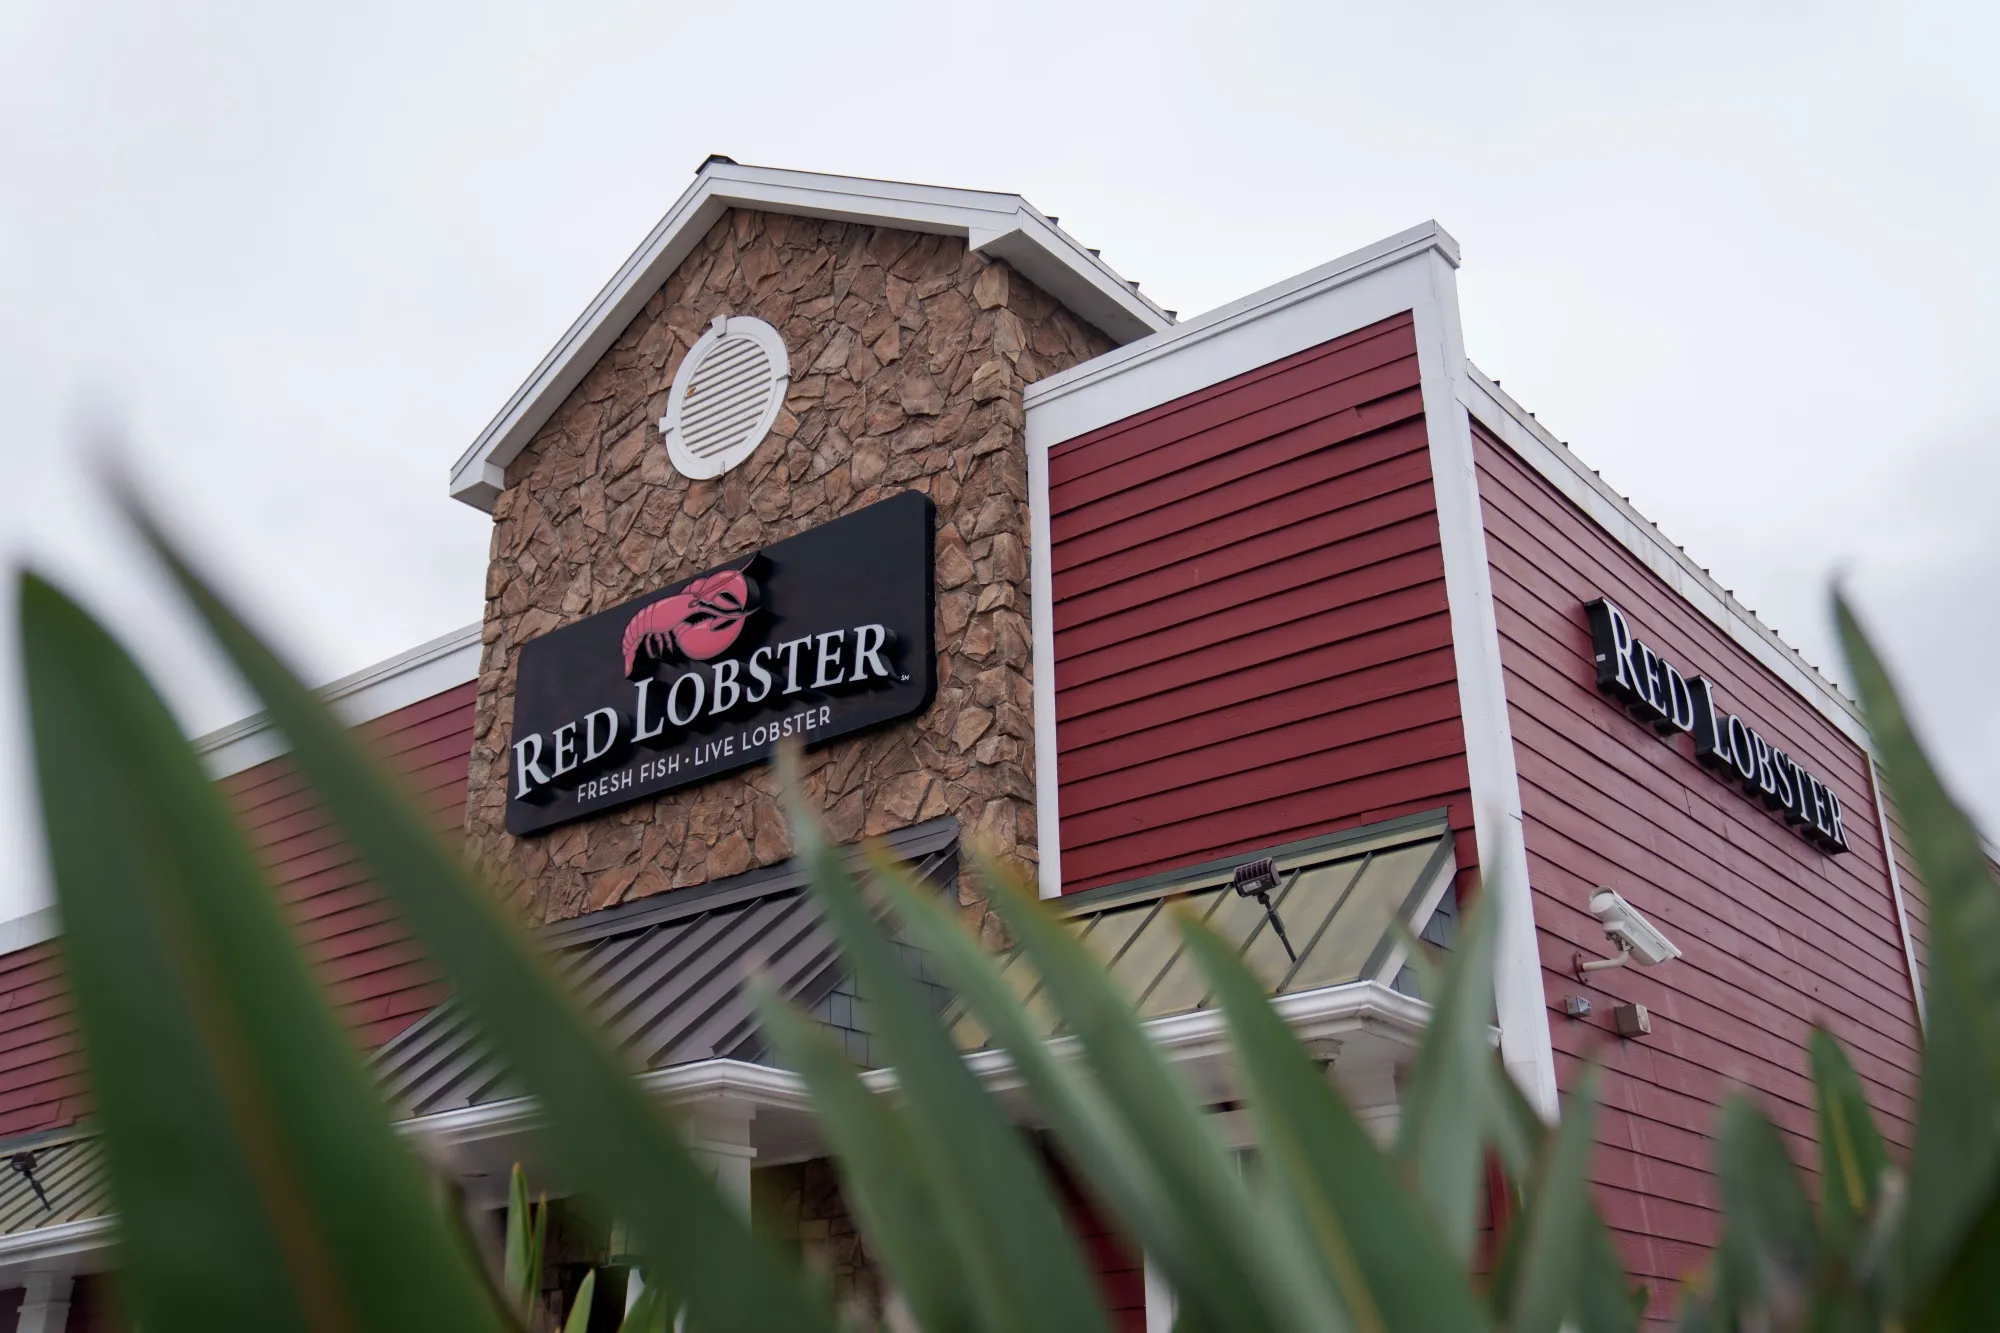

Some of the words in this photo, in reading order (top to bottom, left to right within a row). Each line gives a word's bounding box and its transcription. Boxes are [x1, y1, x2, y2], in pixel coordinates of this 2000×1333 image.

[513, 706, 619, 800] RED
[631, 623, 888, 743] LOBSTER
[577, 768, 633, 803] FRESH
[640, 754, 681, 783] FISH
[694, 736, 734, 766] LIVE
[742, 705, 831, 751] LOBSTER
[1602, 598, 1694, 732] RED
[1699, 675, 1850, 851] LOBSTER
